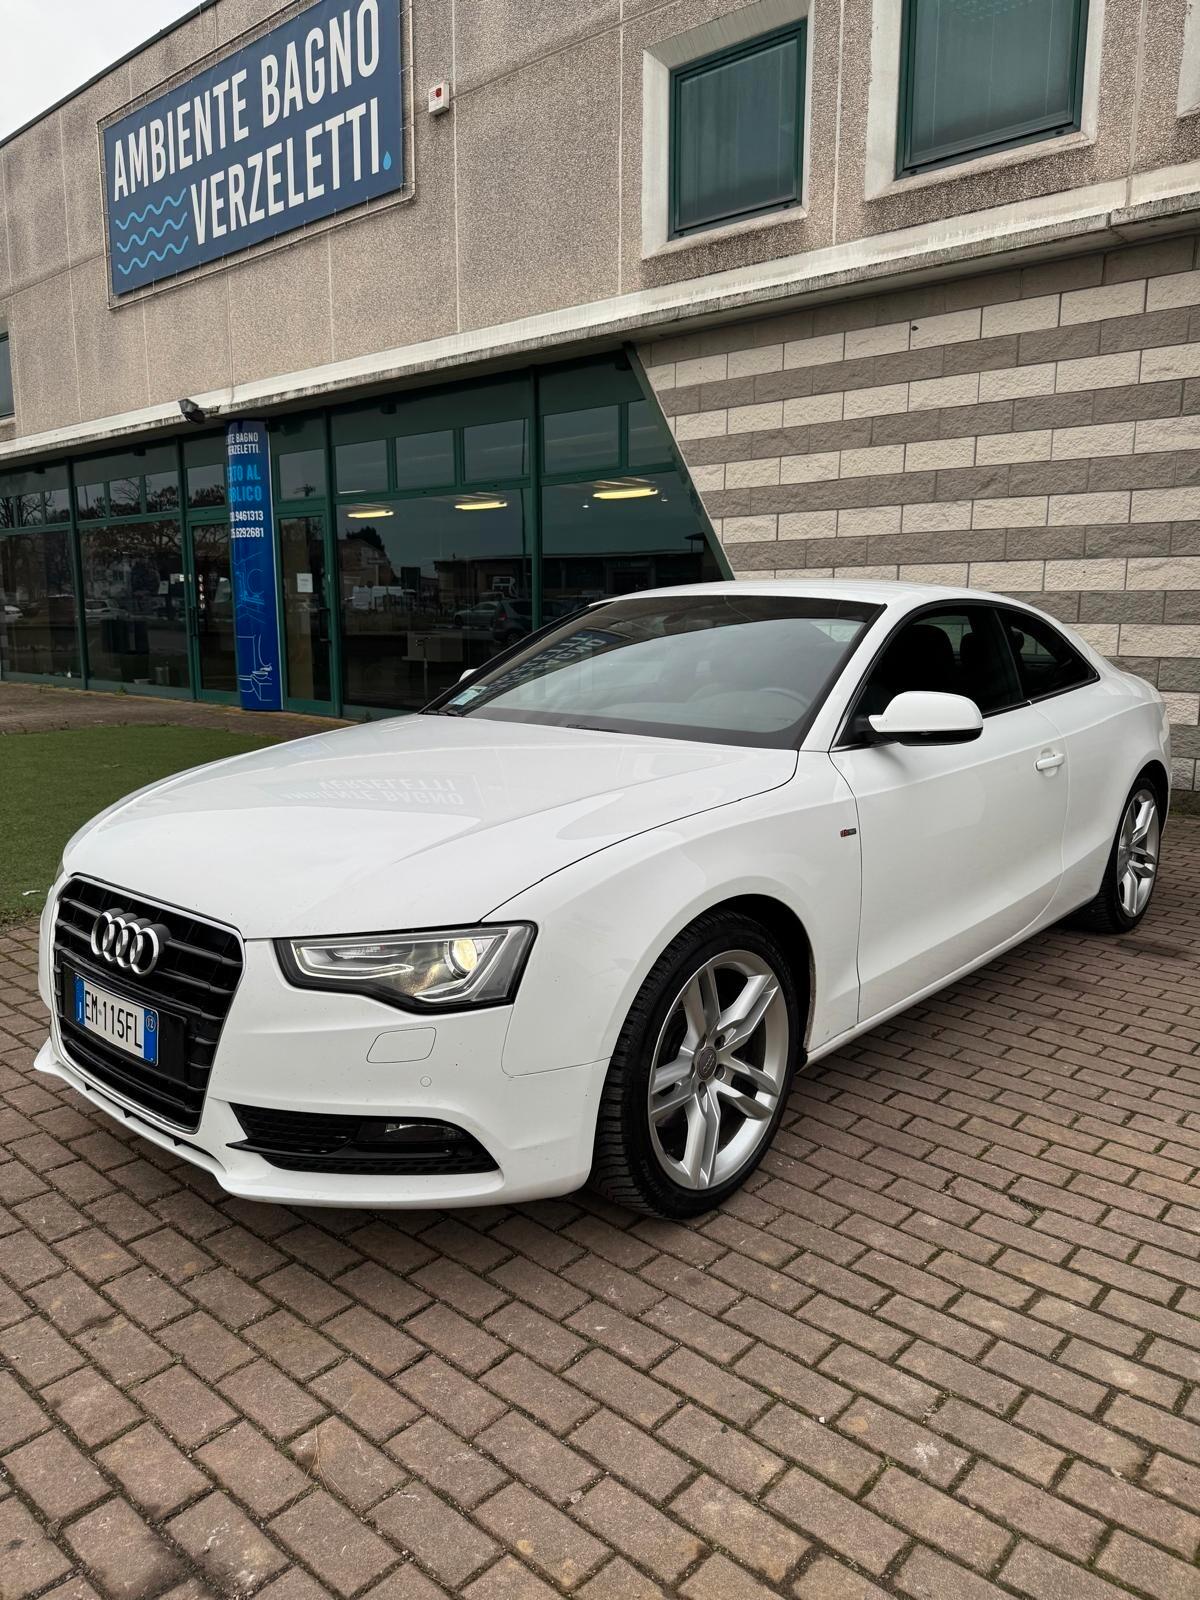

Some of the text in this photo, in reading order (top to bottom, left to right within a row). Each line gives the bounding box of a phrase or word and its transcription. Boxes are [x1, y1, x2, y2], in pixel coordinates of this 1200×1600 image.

[114, 0, 379, 201] AMBIENTE BAGNO
[190, 97, 380, 245] VERZELETTI
[236, 432, 259, 442] BAGNO
[228, 443, 259, 455] ERZELETTI
[246, 464, 261, 480] AL
